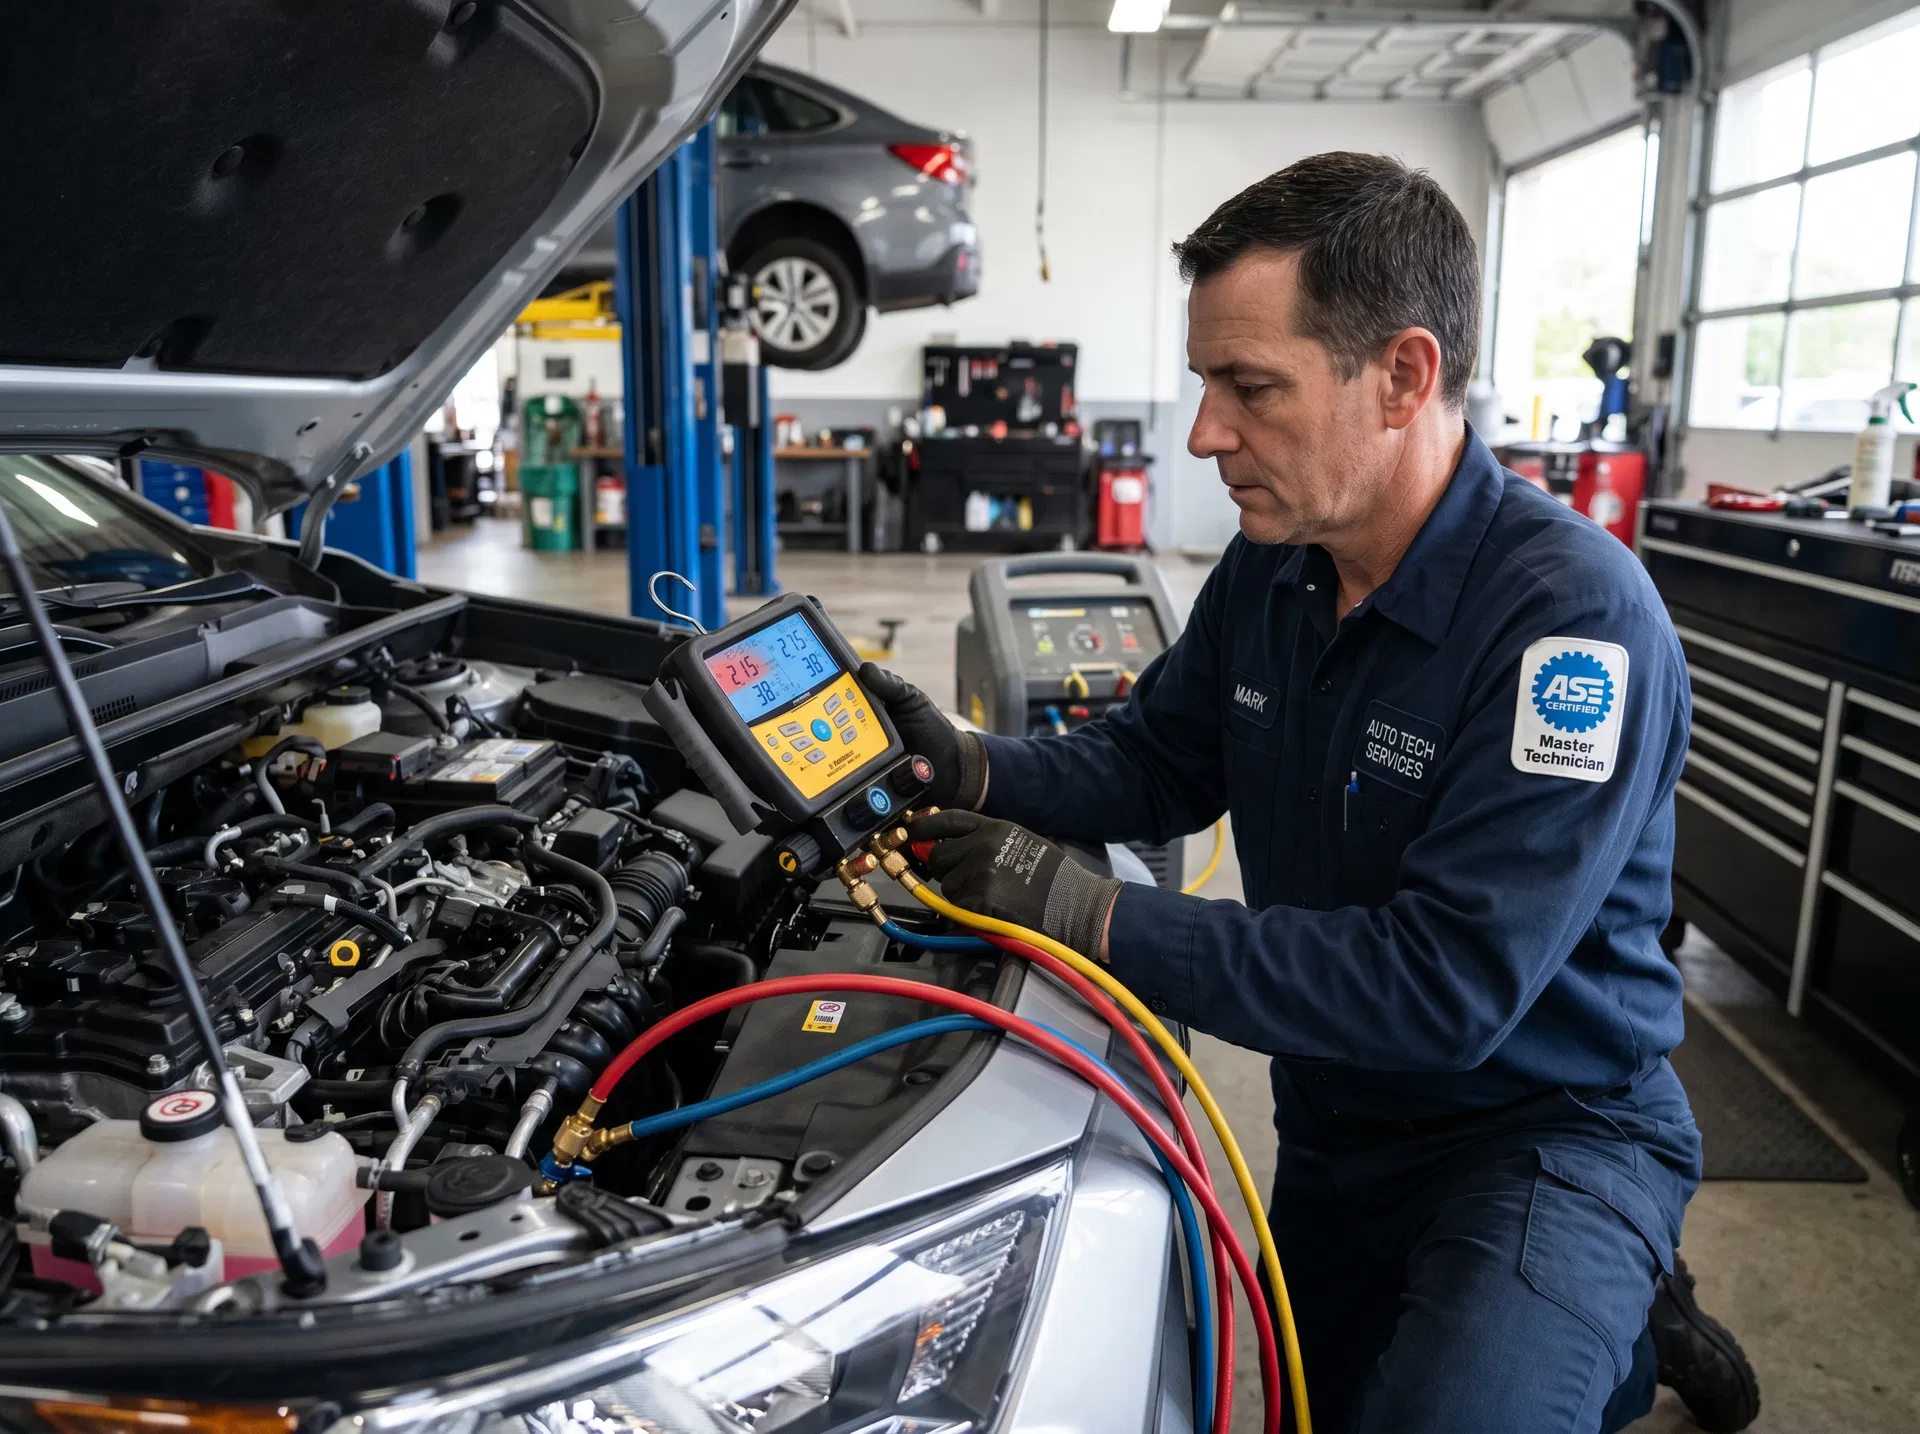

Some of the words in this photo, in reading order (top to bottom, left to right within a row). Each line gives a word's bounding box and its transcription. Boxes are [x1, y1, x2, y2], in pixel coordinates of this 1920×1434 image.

[801, 653, 824, 678] 38
[752, 680, 776, 706] 38
[1233, 684, 1268, 713] MARK
[1541, 674, 1605, 705] ASE
[1545, 700, 1599, 715] CERTIFIED
[1366, 719, 1398, 746] AUTO
[1400, 731, 1436, 761] TECH
[1539, 734, 1595, 754] Master
[1365, 742, 1424, 780] SERVICES
[1524, 748, 1605, 772] Technician
